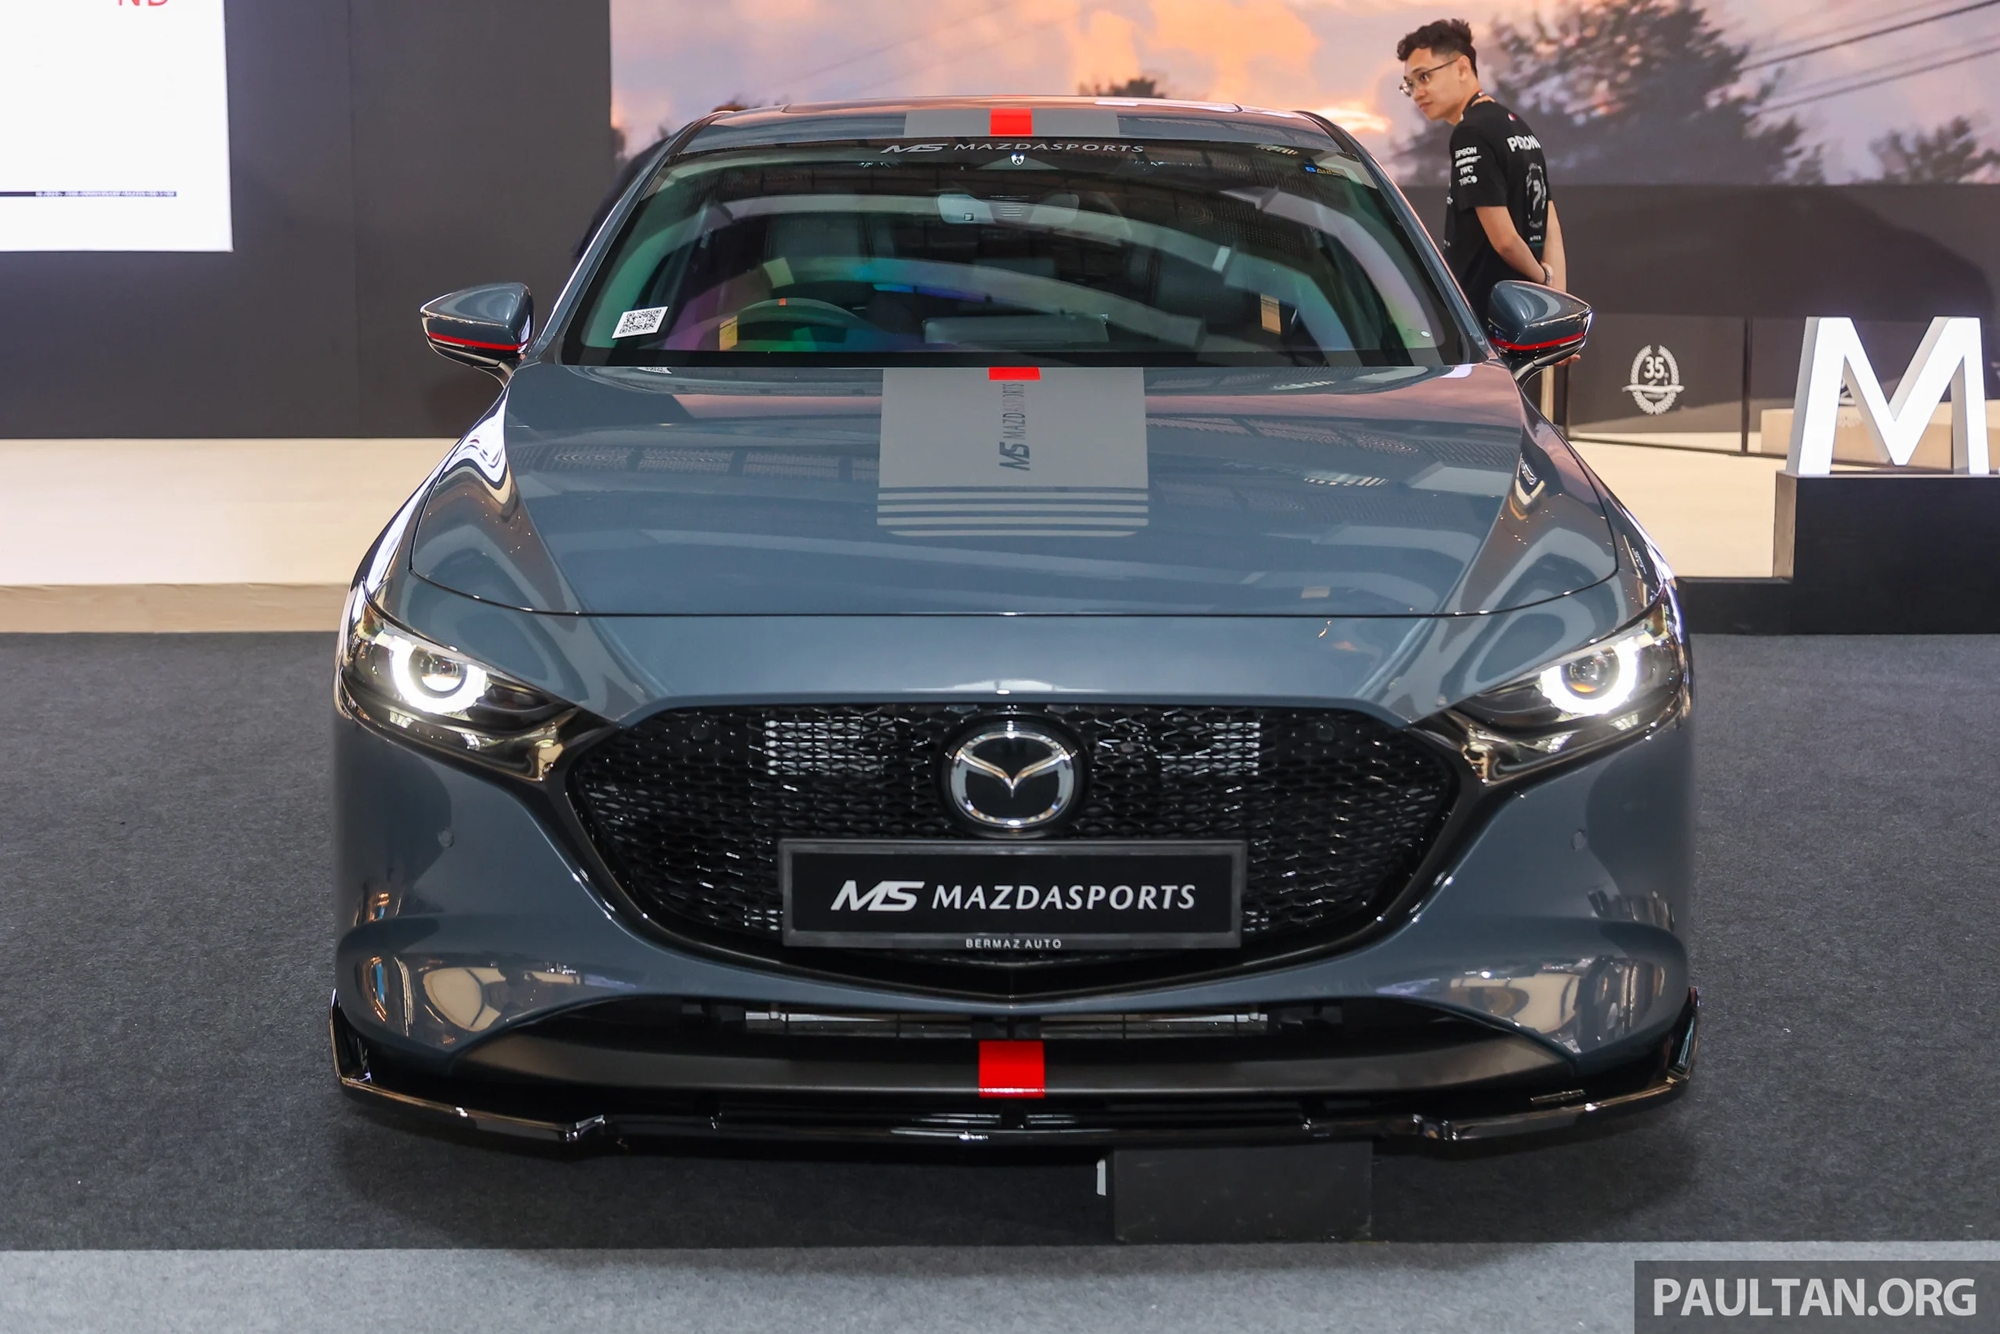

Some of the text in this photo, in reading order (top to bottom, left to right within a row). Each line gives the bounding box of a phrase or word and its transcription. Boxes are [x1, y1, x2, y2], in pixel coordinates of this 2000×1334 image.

[880, 142, 1145, 154] MS MAZDASPORTS
[1643, 356, 1665, 379] 35
[999, 383, 1030, 471] MS MAZDASPORTS
[830, 879, 1197, 912] MS MAZDASPORTS
[965, 938, 1063, 949] BERMAZ AUTO
